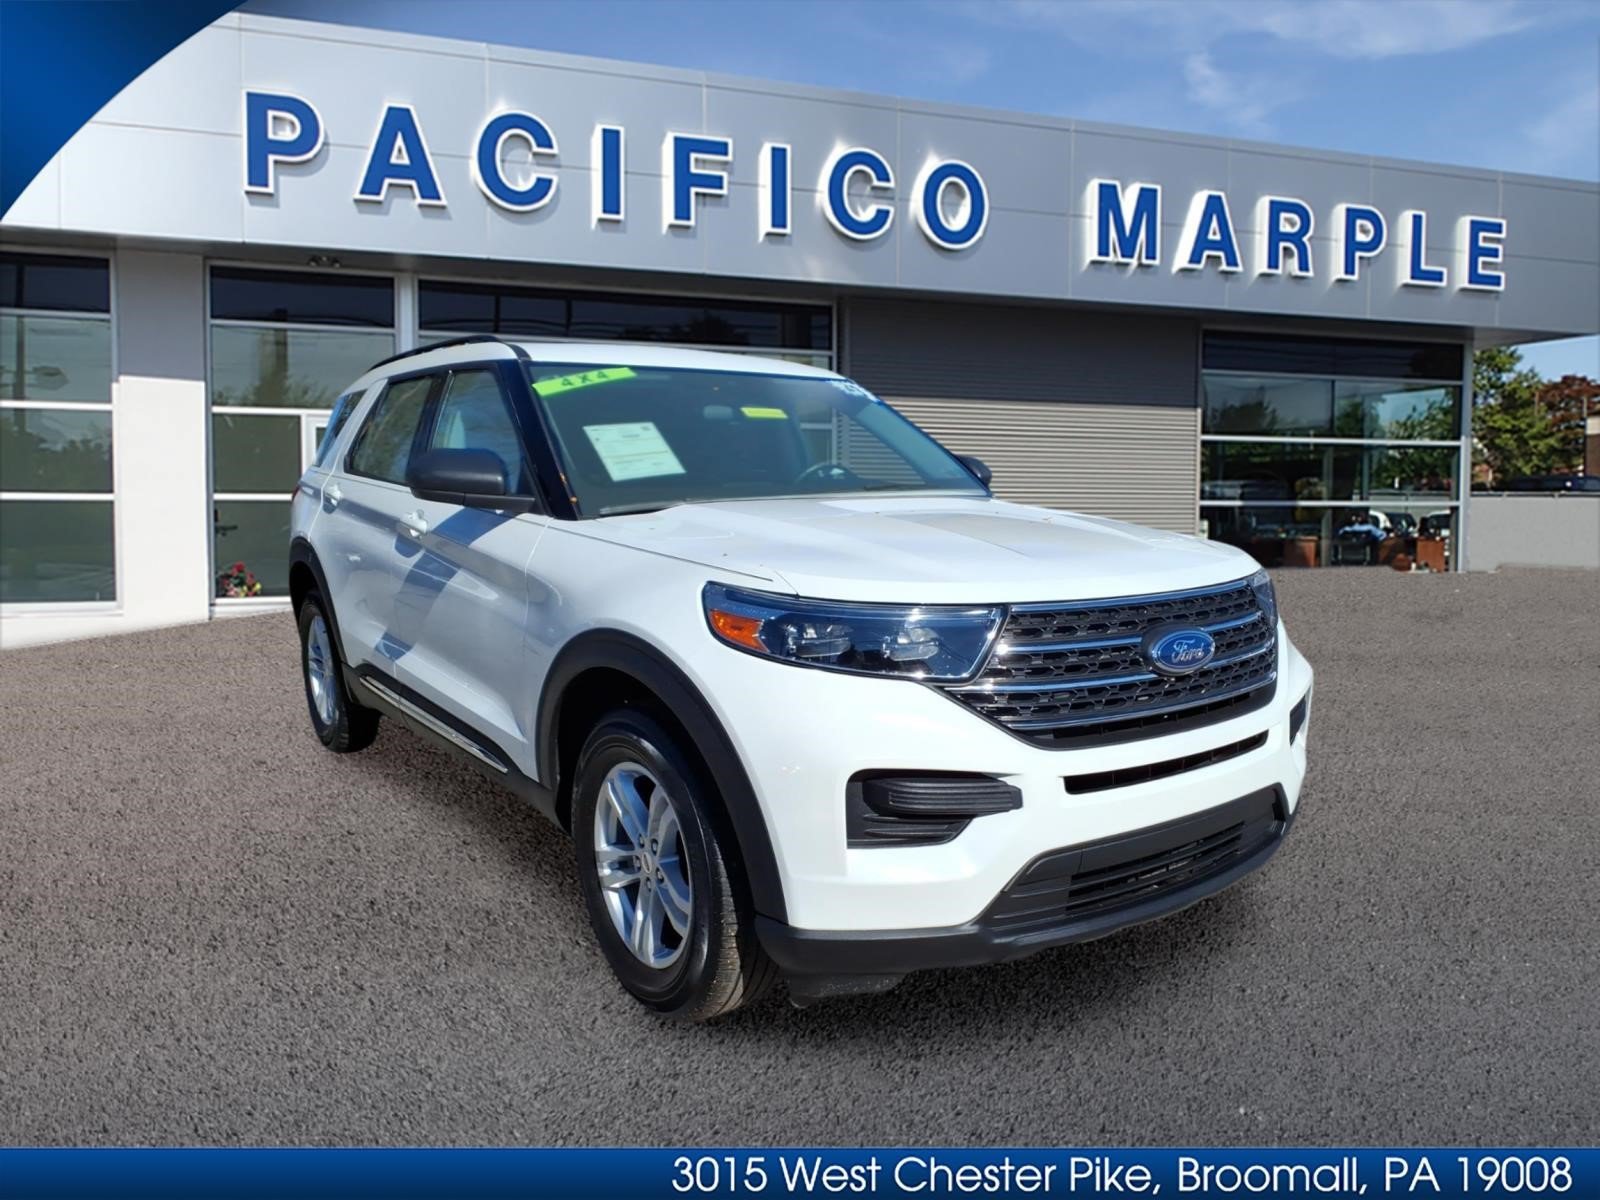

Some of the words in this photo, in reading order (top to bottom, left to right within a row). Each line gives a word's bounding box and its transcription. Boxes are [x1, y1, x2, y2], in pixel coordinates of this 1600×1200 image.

[243, 89, 990, 249] PACIFICO
[1088, 180, 1507, 292] MARPLE
[1171, 638, 1205, 663] Ford
